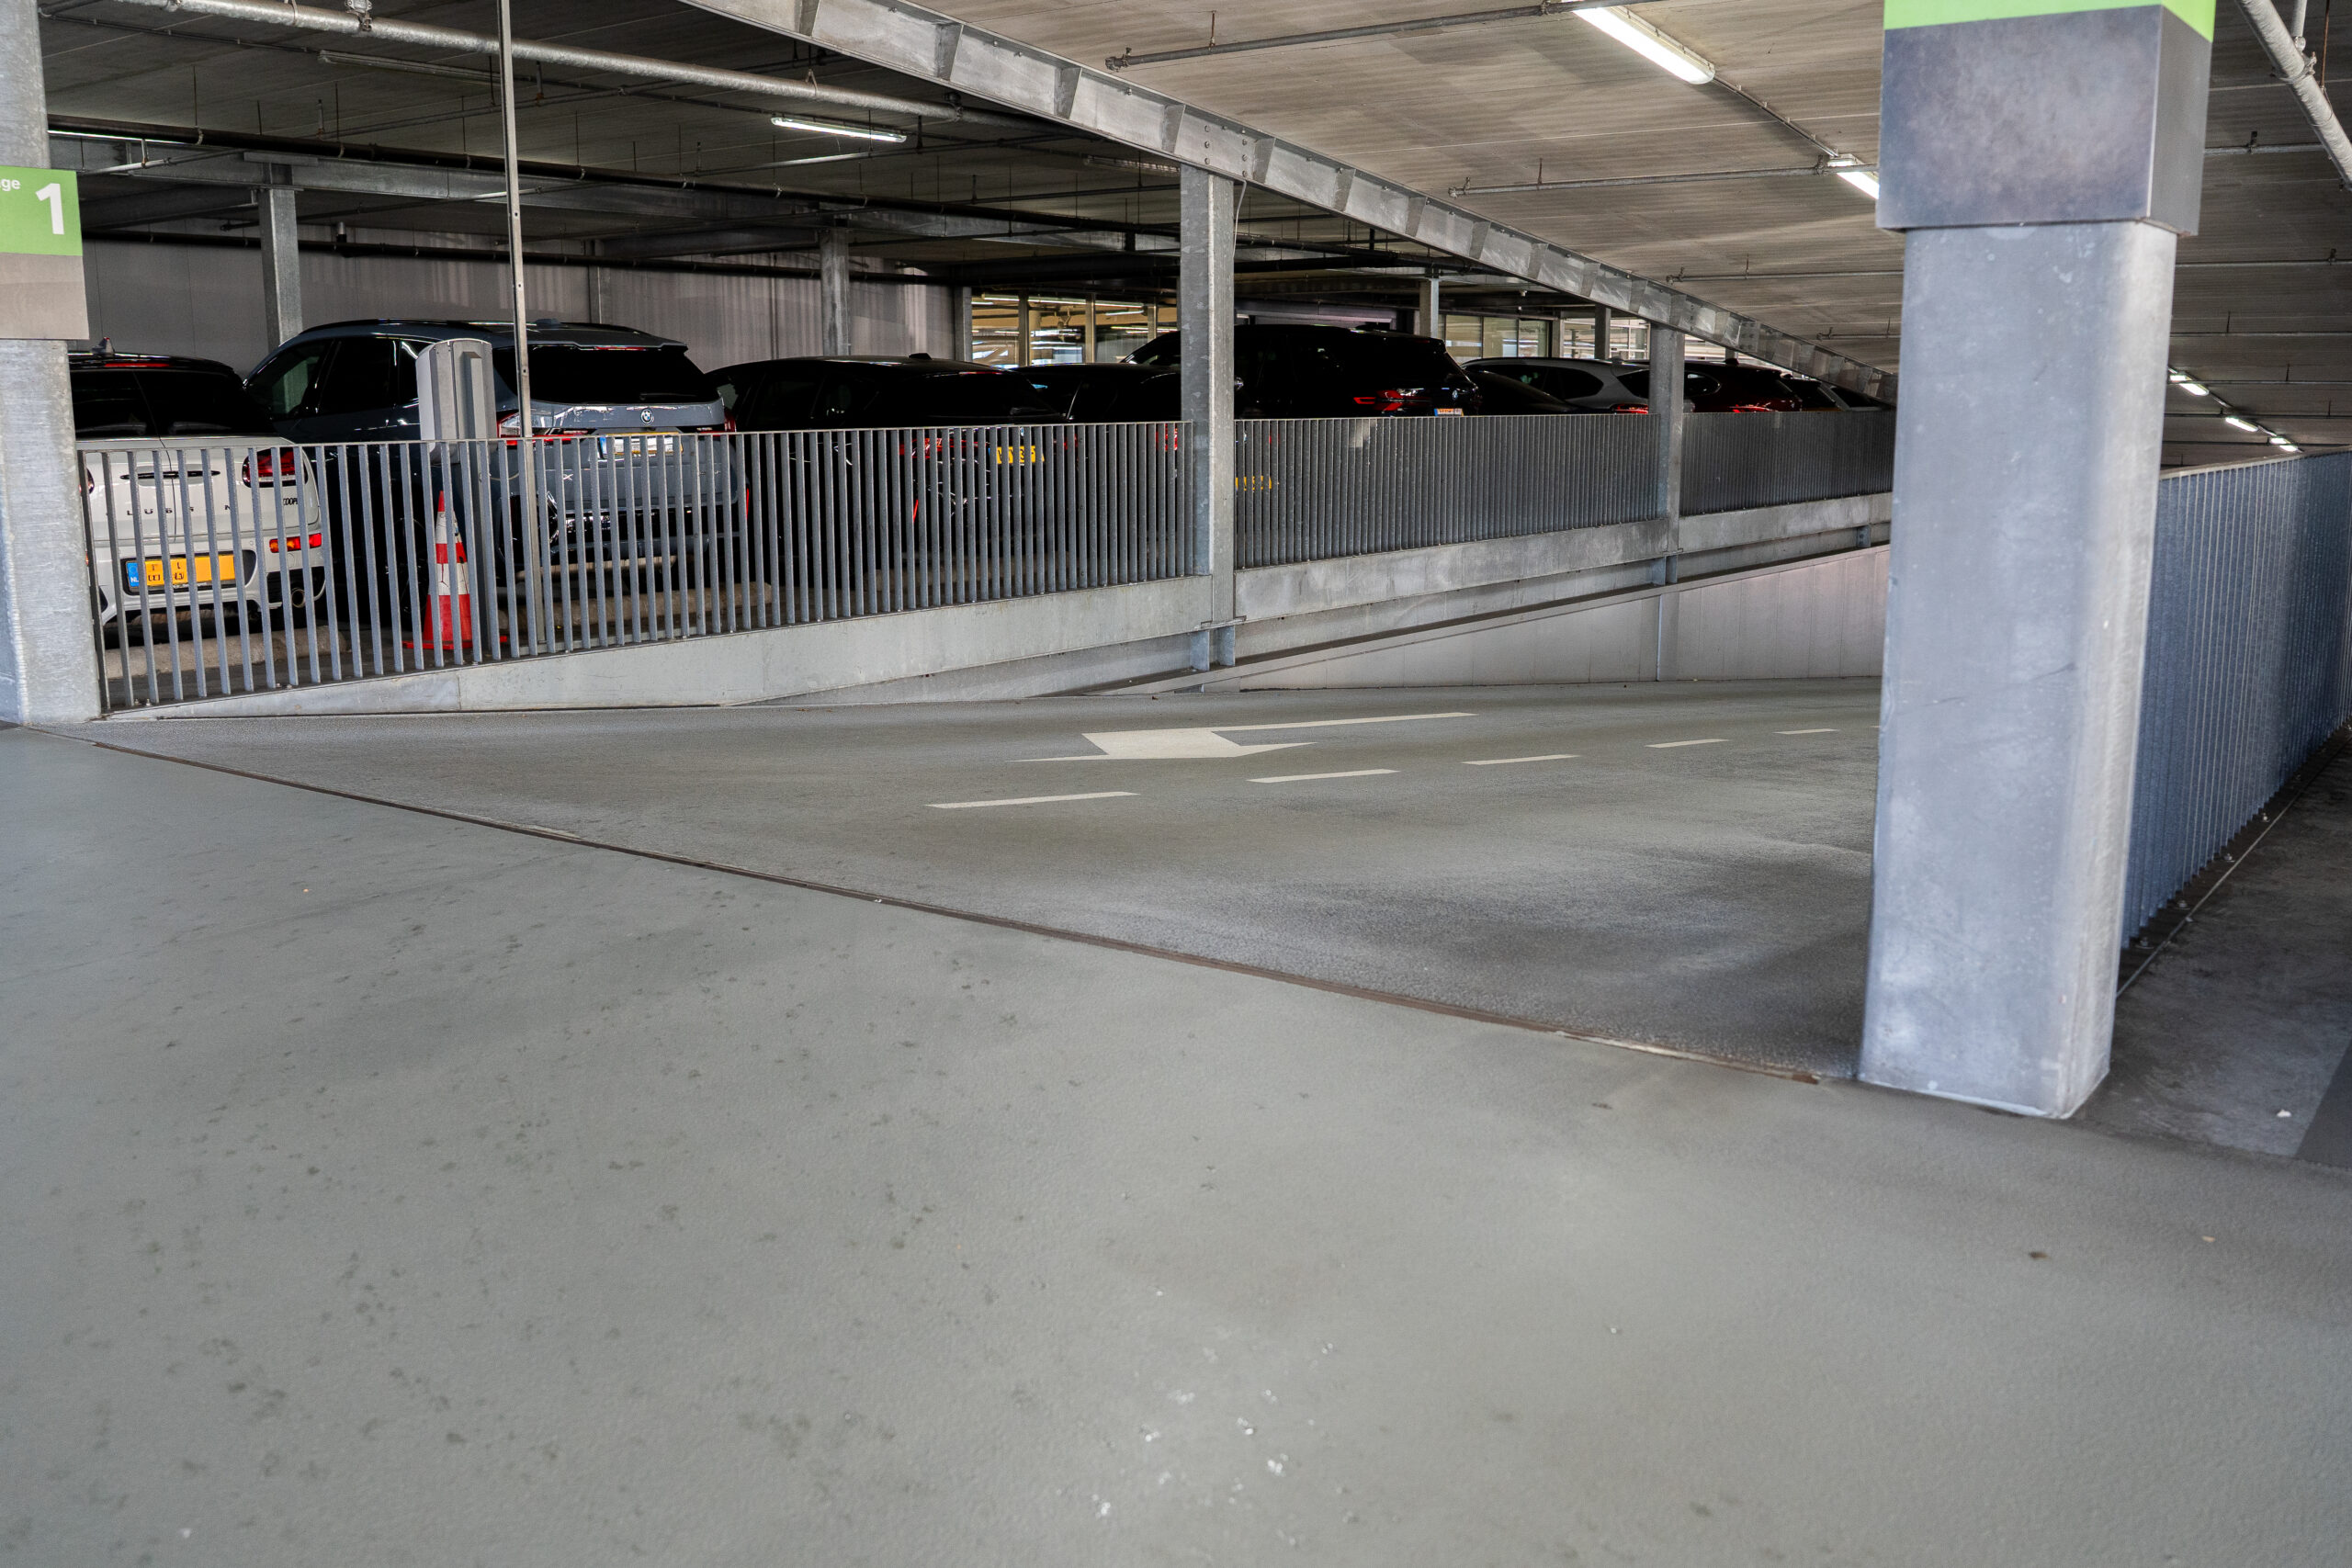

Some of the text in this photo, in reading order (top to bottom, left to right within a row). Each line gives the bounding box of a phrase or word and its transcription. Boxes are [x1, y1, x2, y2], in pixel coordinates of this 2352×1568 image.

[0, 179, 21, 192] ge
[35, 183, 64, 235] 1
[283, 497, 299, 506] COOP
